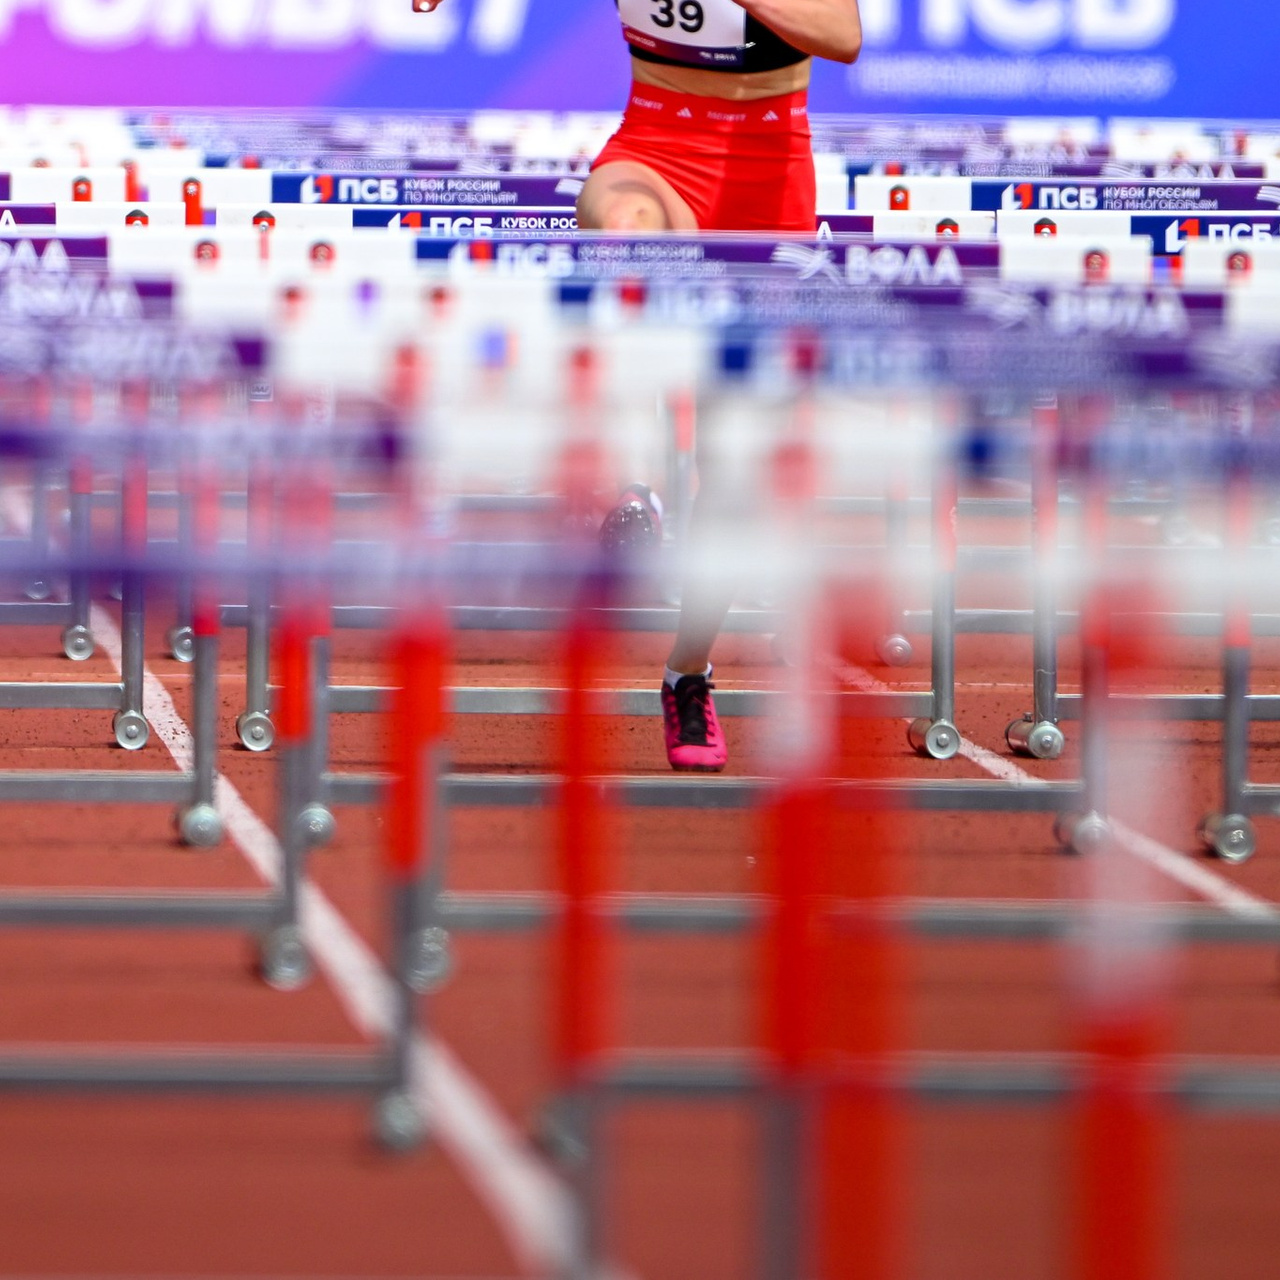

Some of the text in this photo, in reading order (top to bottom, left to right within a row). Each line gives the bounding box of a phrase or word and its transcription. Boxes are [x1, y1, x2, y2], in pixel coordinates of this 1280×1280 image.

[338, 178, 398, 203] ПСБ
[403, 178, 500, 191] КУБОК РОССИИ
[1103, 186, 1200, 199] КУБОК РОССИИ
[1038, 186, 1098, 210] ПСБ
[430, 217, 494, 238] ПСБ
[501, 218, 546, 228] КУБОК
[1208, 223, 1273, 245] ПСБ
[496, 241, 576, 278] ПСБ
[845, 244, 962, 286] ВФЛА
